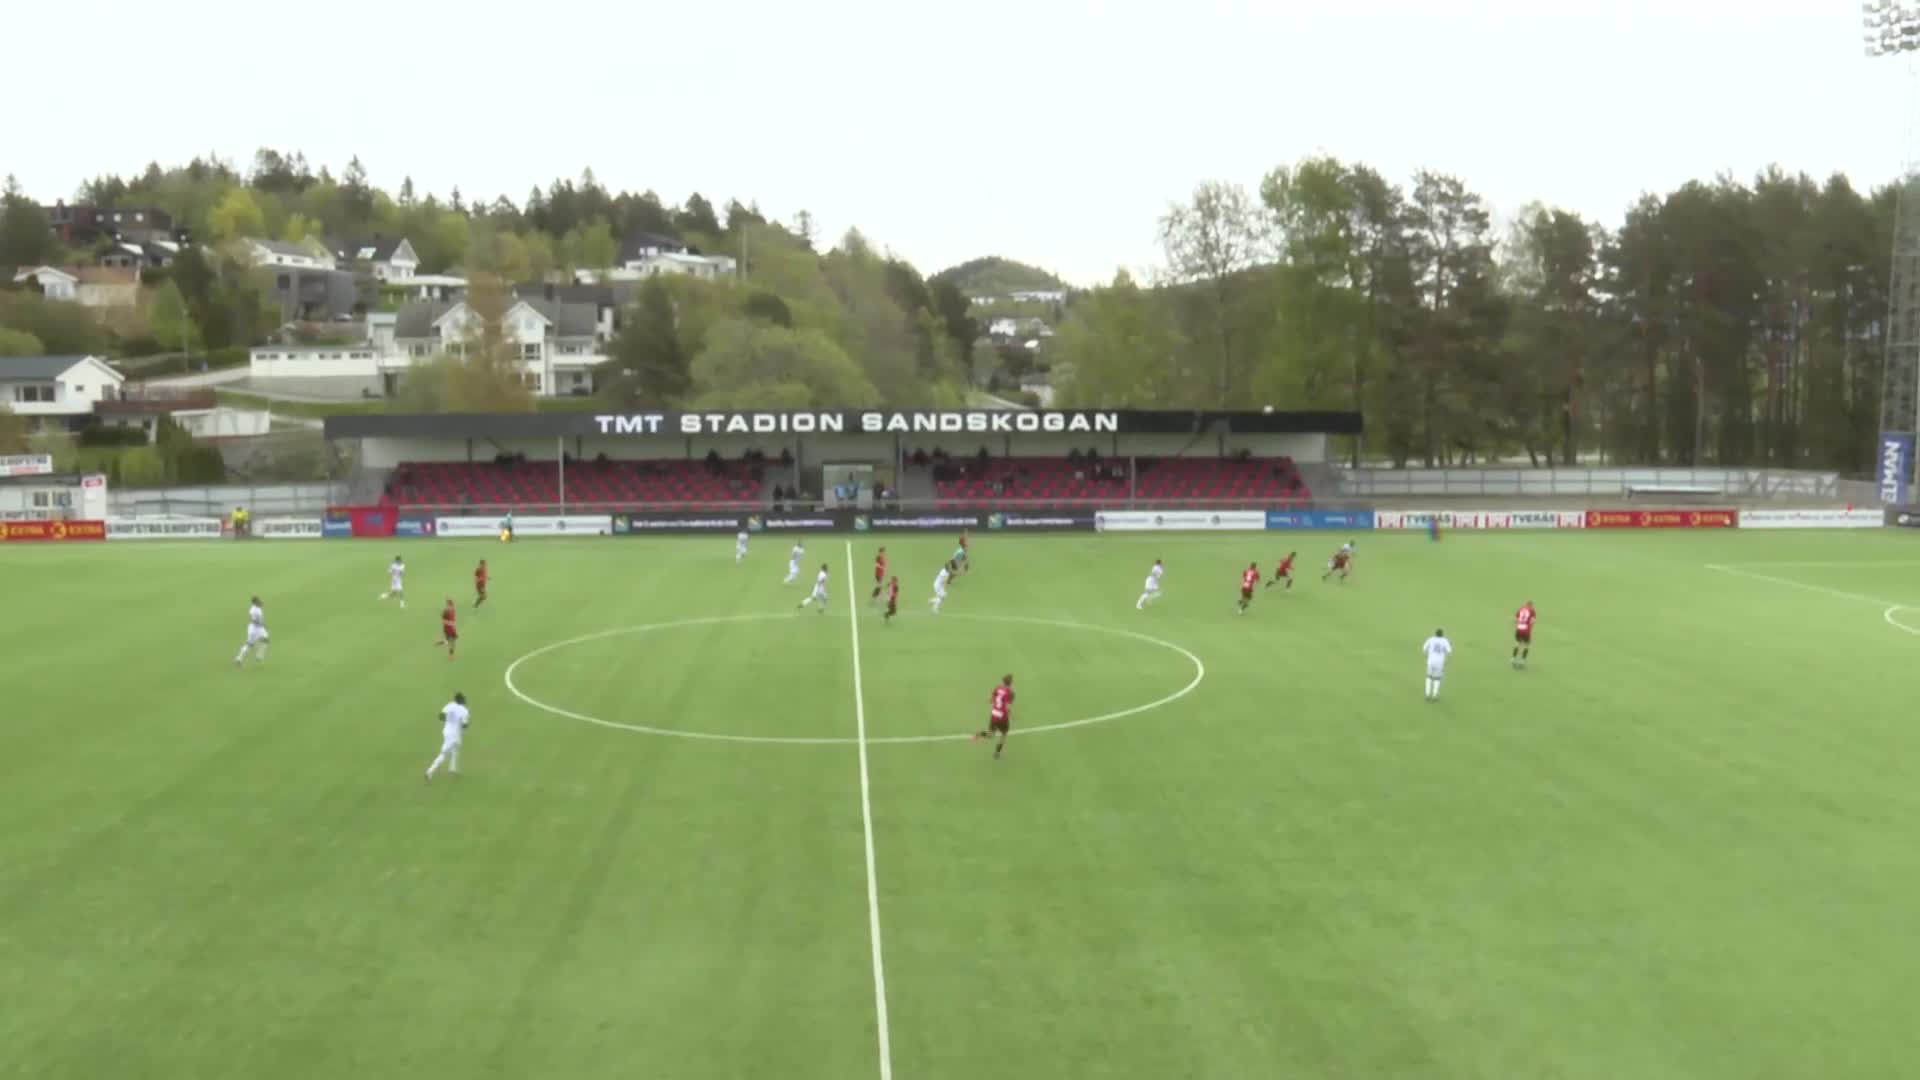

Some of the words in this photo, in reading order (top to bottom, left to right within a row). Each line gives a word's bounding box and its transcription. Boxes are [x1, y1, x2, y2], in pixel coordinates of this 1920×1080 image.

[595, 415, 663, 433] TMT
[681, 413, 844, 432] STADION
[861, 412, 1118, 432] SANDSKOGAN
